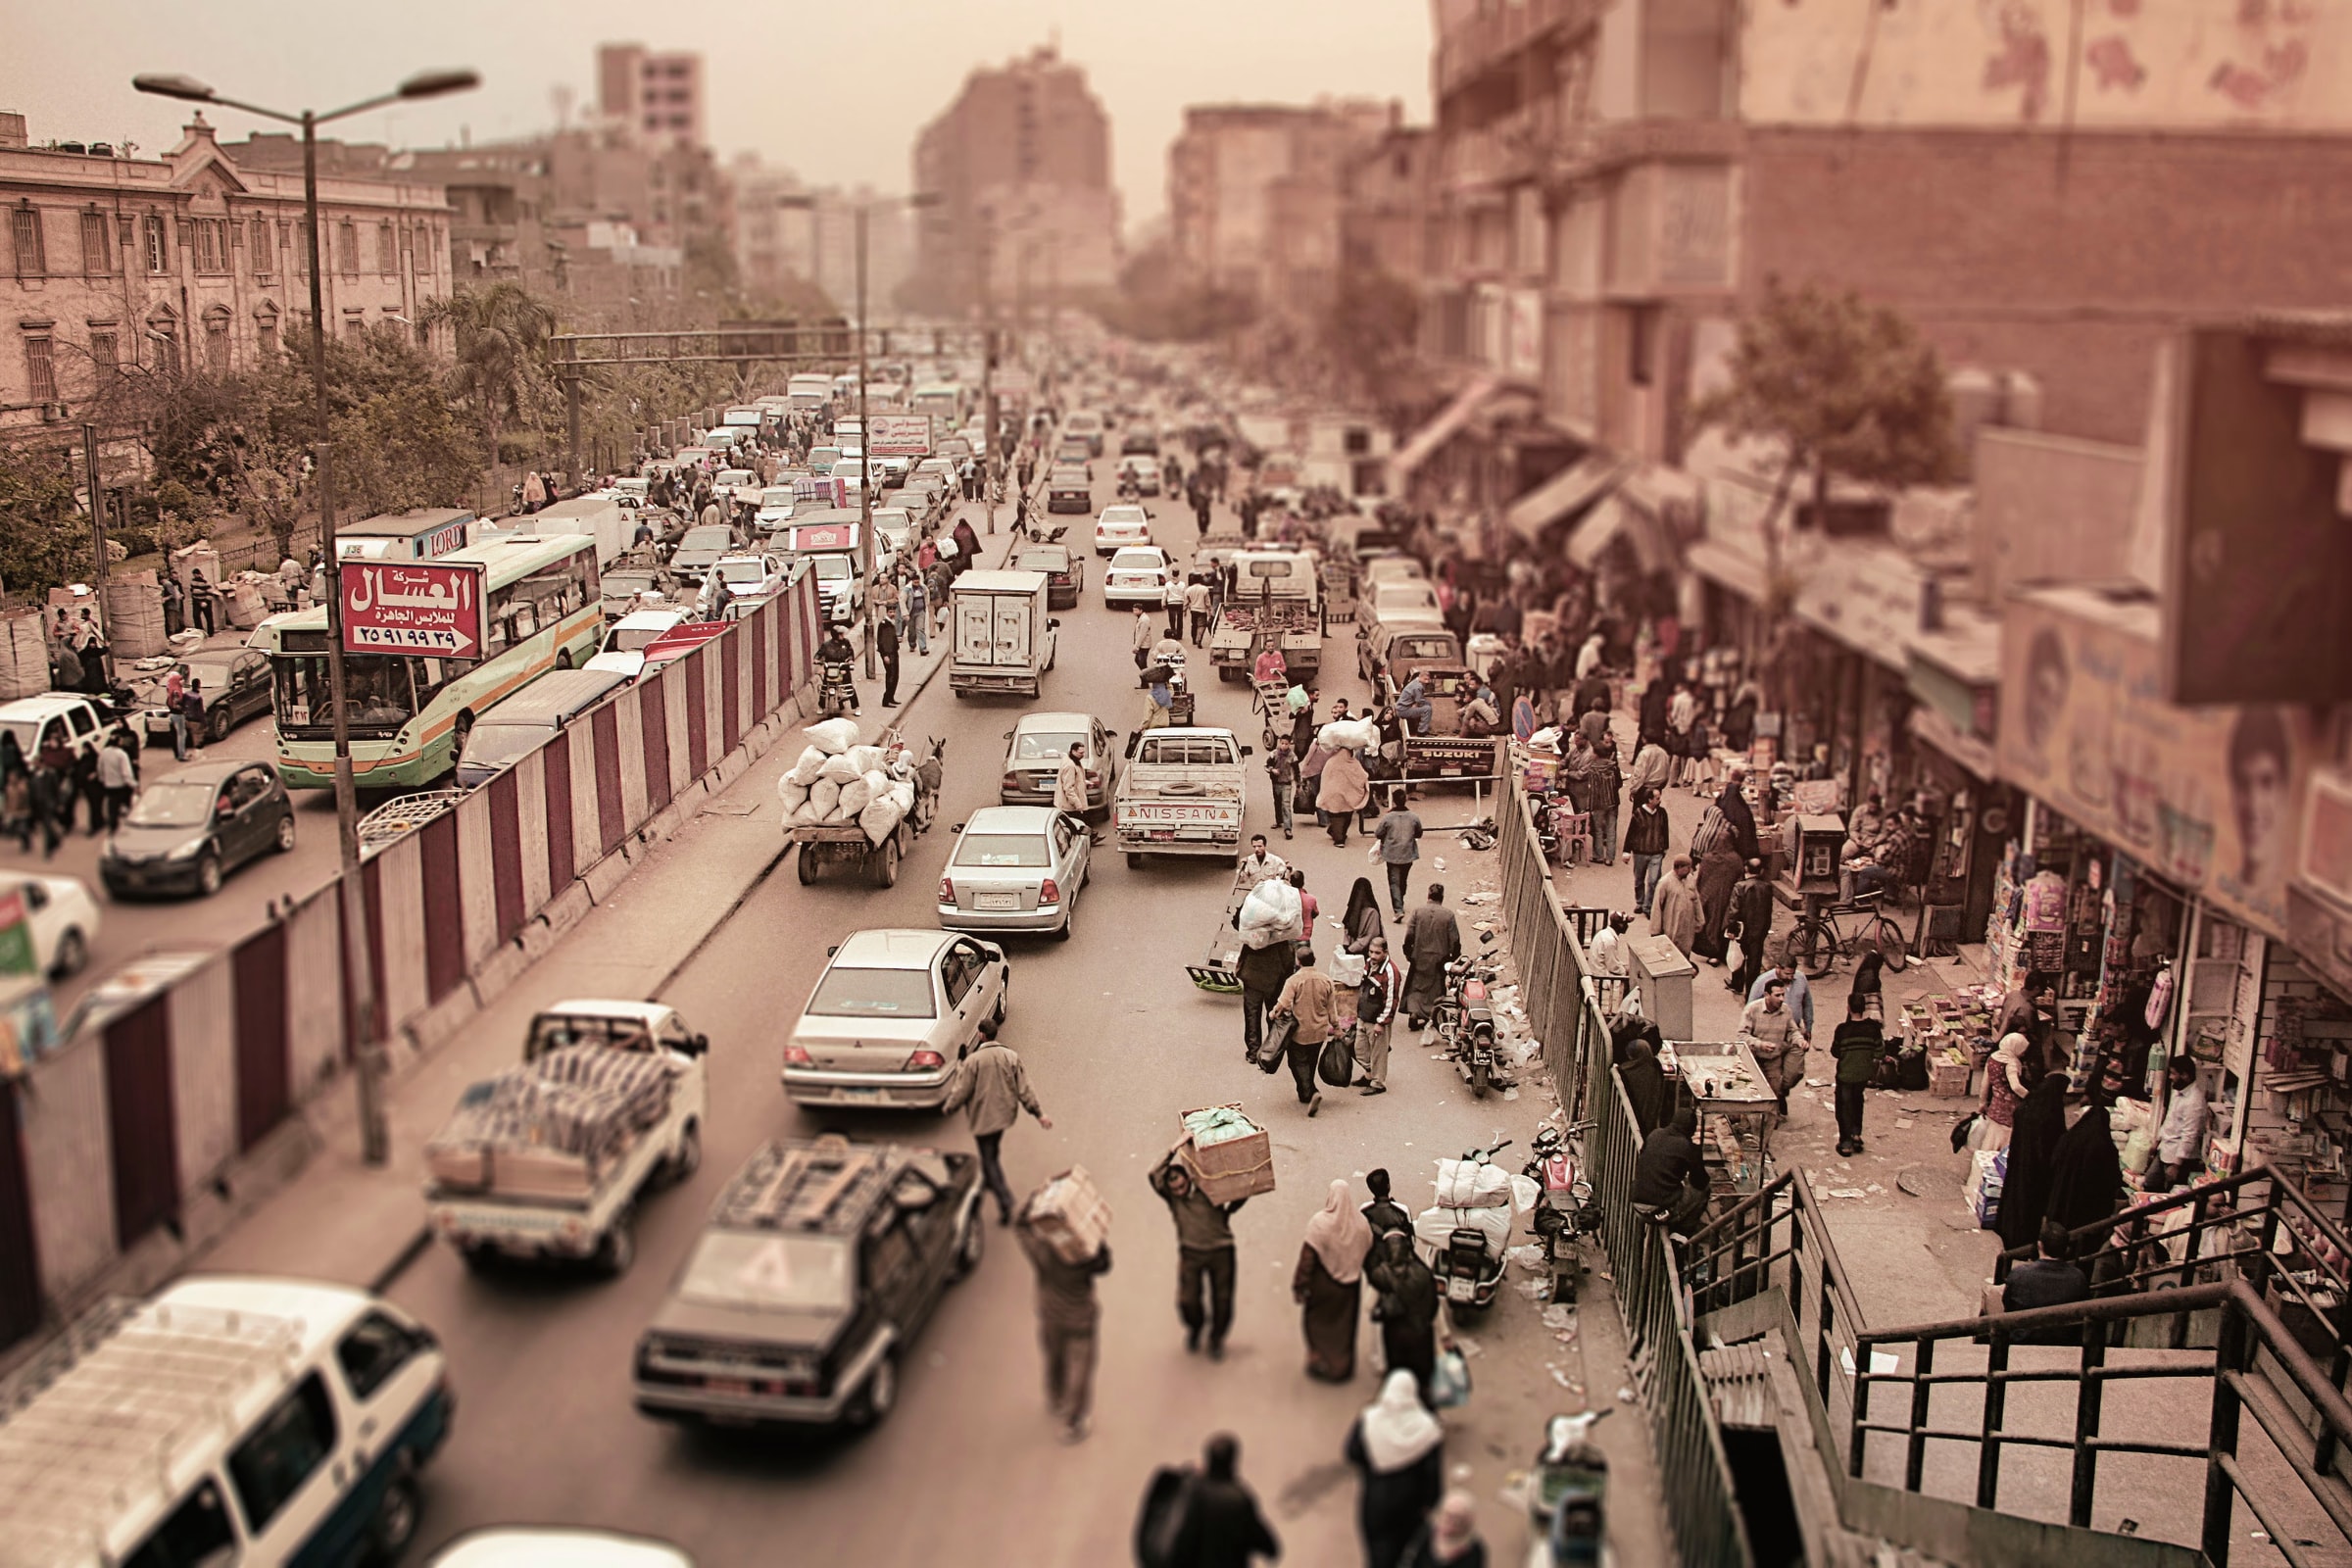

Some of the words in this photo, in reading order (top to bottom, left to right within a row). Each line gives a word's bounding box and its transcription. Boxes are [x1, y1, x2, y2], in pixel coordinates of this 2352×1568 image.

[429, 524, 464, 557] LORD
[392, 569, 429, 584] شركة
[350, 567, 471, 612] العسال
[374, 607, 414, 624] الجاهزة
[415, 612, 456, 626] للملابس
[360, 627, 380, 642] ٢٥
[384, 628, 403, 644] ٩١
[408, 630, 429, 646] ٩٩
[433, 631, 457, 648] ٣٩
[1140, 808, 1216, 819] NISSAN
